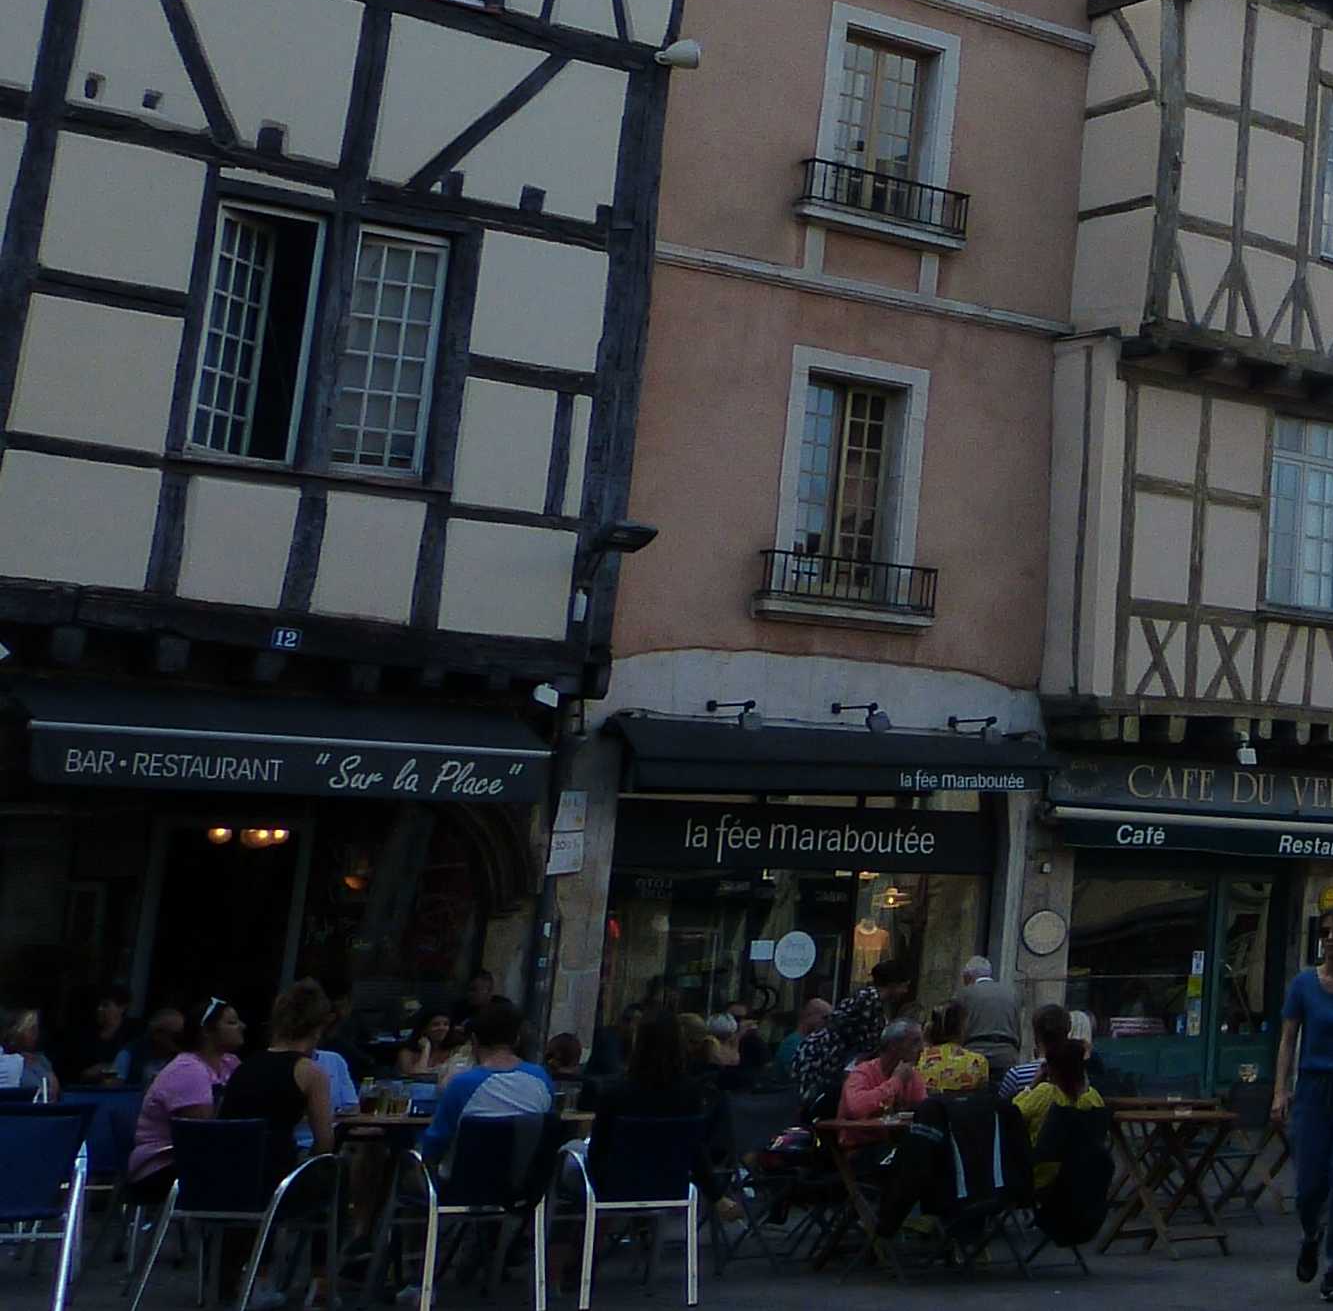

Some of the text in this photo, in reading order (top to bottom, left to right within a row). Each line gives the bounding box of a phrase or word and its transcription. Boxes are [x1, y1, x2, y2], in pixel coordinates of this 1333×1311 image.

[275, 630, 298, 648] 12
[64, 748, 284, 783] BAR RESTAURANT
[392, 758, 419, 792] la
[900, 769, 1025, 791] la fée maraboutée
[1127, 764, 1216, 803] CAFE
[1231, 770, 1276, 805] DU
[683, 813, 936, 864] la fée maraboutée
[1116, 823, 1166, 846] Café
